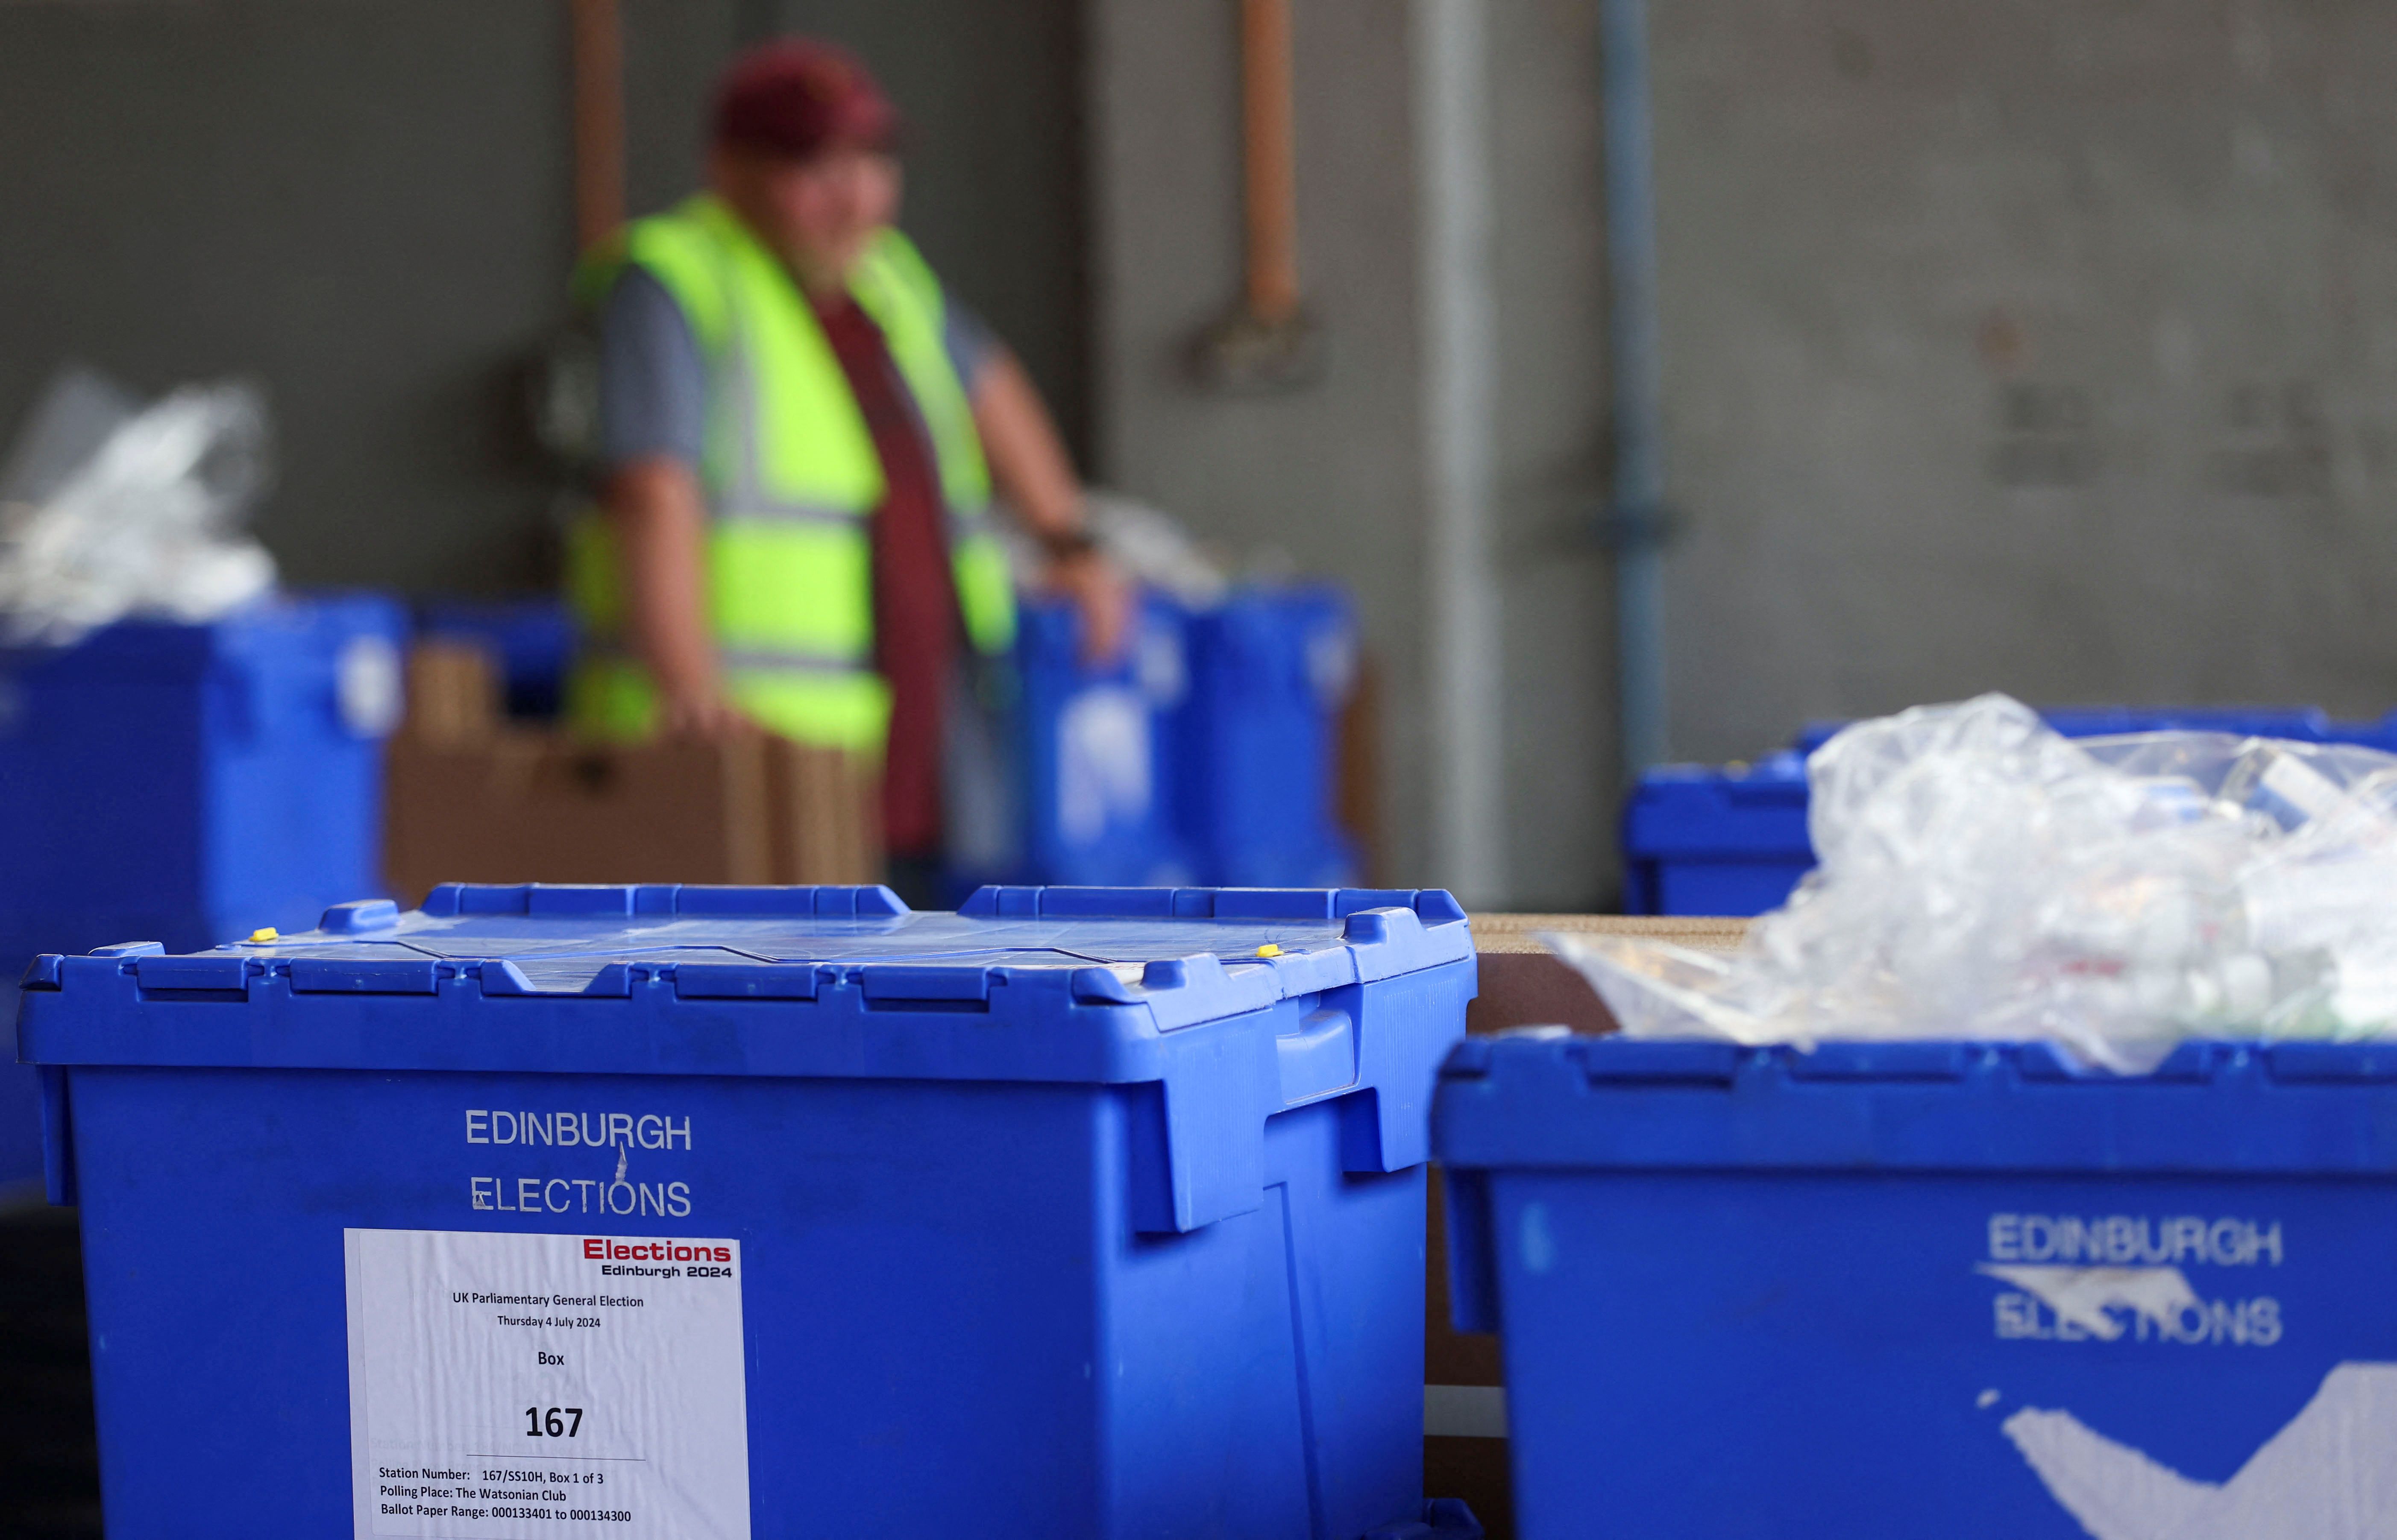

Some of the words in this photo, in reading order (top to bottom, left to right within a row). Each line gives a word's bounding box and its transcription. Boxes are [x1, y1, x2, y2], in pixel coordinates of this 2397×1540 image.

[466, 1110, 691, 1150] EDINBURGH
[471, 1177, 691, 1217] ELECTIONS
[1988, 1213, 2283, 1266] EDINBURGH
[584, 1239, 731, 1262] Elections
[601, 1265, 681, 1279] Edinburgh
[687, 1266, 732, 1278] 2024
[453, 1292, 469, 1303] UK
[472, 1292, 550, 1308] Parliamentary
[553, 1294, 596, 1306] General
[600, 1295, 644, 1307] Election
[497, 1315, 543, 1329] Thursday
[546, 1317, 552, 1326] 4
[555, 1317, 574, 1329] July
[576, 1317, 601, 1328] 2024
[1994, 1292, 2283, 1346] ELIONS
[538, 1351, 565, 1365] Box
[525, 1407, 583, 1438] 167
[379, 1467, 419, 1479] Station
[422, 1468, 470, 1480] Number:
[482, 1470, 546, 1484] 167/SS10H,
[549, 1472, 570, 1483] Box
[573, 1473, 579, 1483] 1
[583, 1473, 594, 1484] of
[597, 1473, 604, 1484] 3
[380, 1485, 418, 1499] Polling
[421, 1486, 453, 1498] Place:
[455, 1487, 476, 1499] The
[479, 1488, 539, 1500] Watsonian
[542, 1490, 566, 1502] Club
[381, 1503, 414, 1515] Ballot
[417, 1505, 448, 1518] Paper
[451, 1505, 489, 1520] Range:
[492, 1507, 552, 1519] 000133401
[555, 1510, 567, 1520] to
[570, 1509, 631, 1522] 000134300
